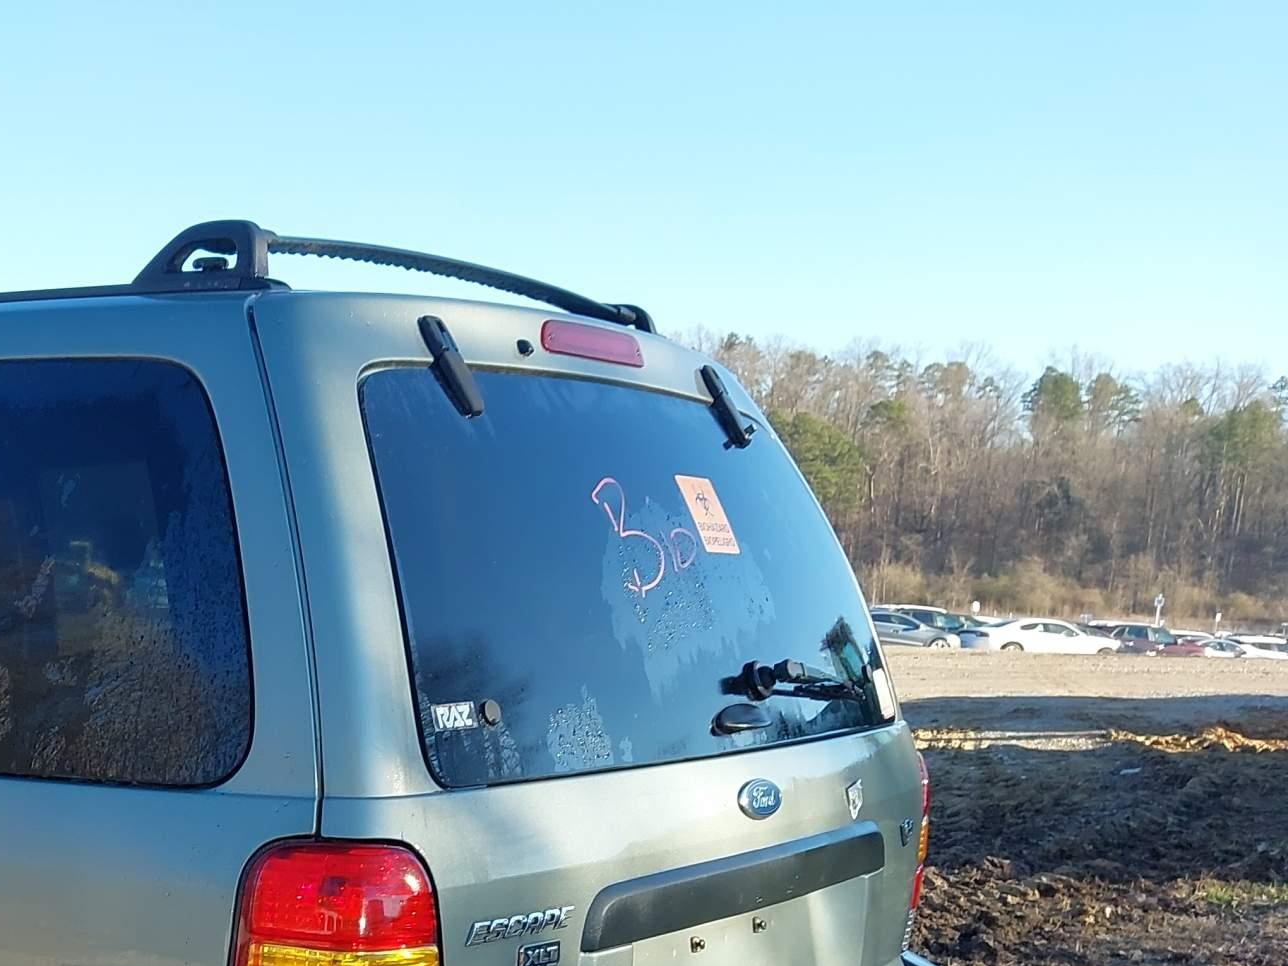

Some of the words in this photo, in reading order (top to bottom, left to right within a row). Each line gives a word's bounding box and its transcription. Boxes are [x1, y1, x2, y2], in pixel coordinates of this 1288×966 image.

[751, 786, 777, 810] Ford
[464, 905, 575, 947] ESCAPE
[524, 945, 559, 966] XLT
